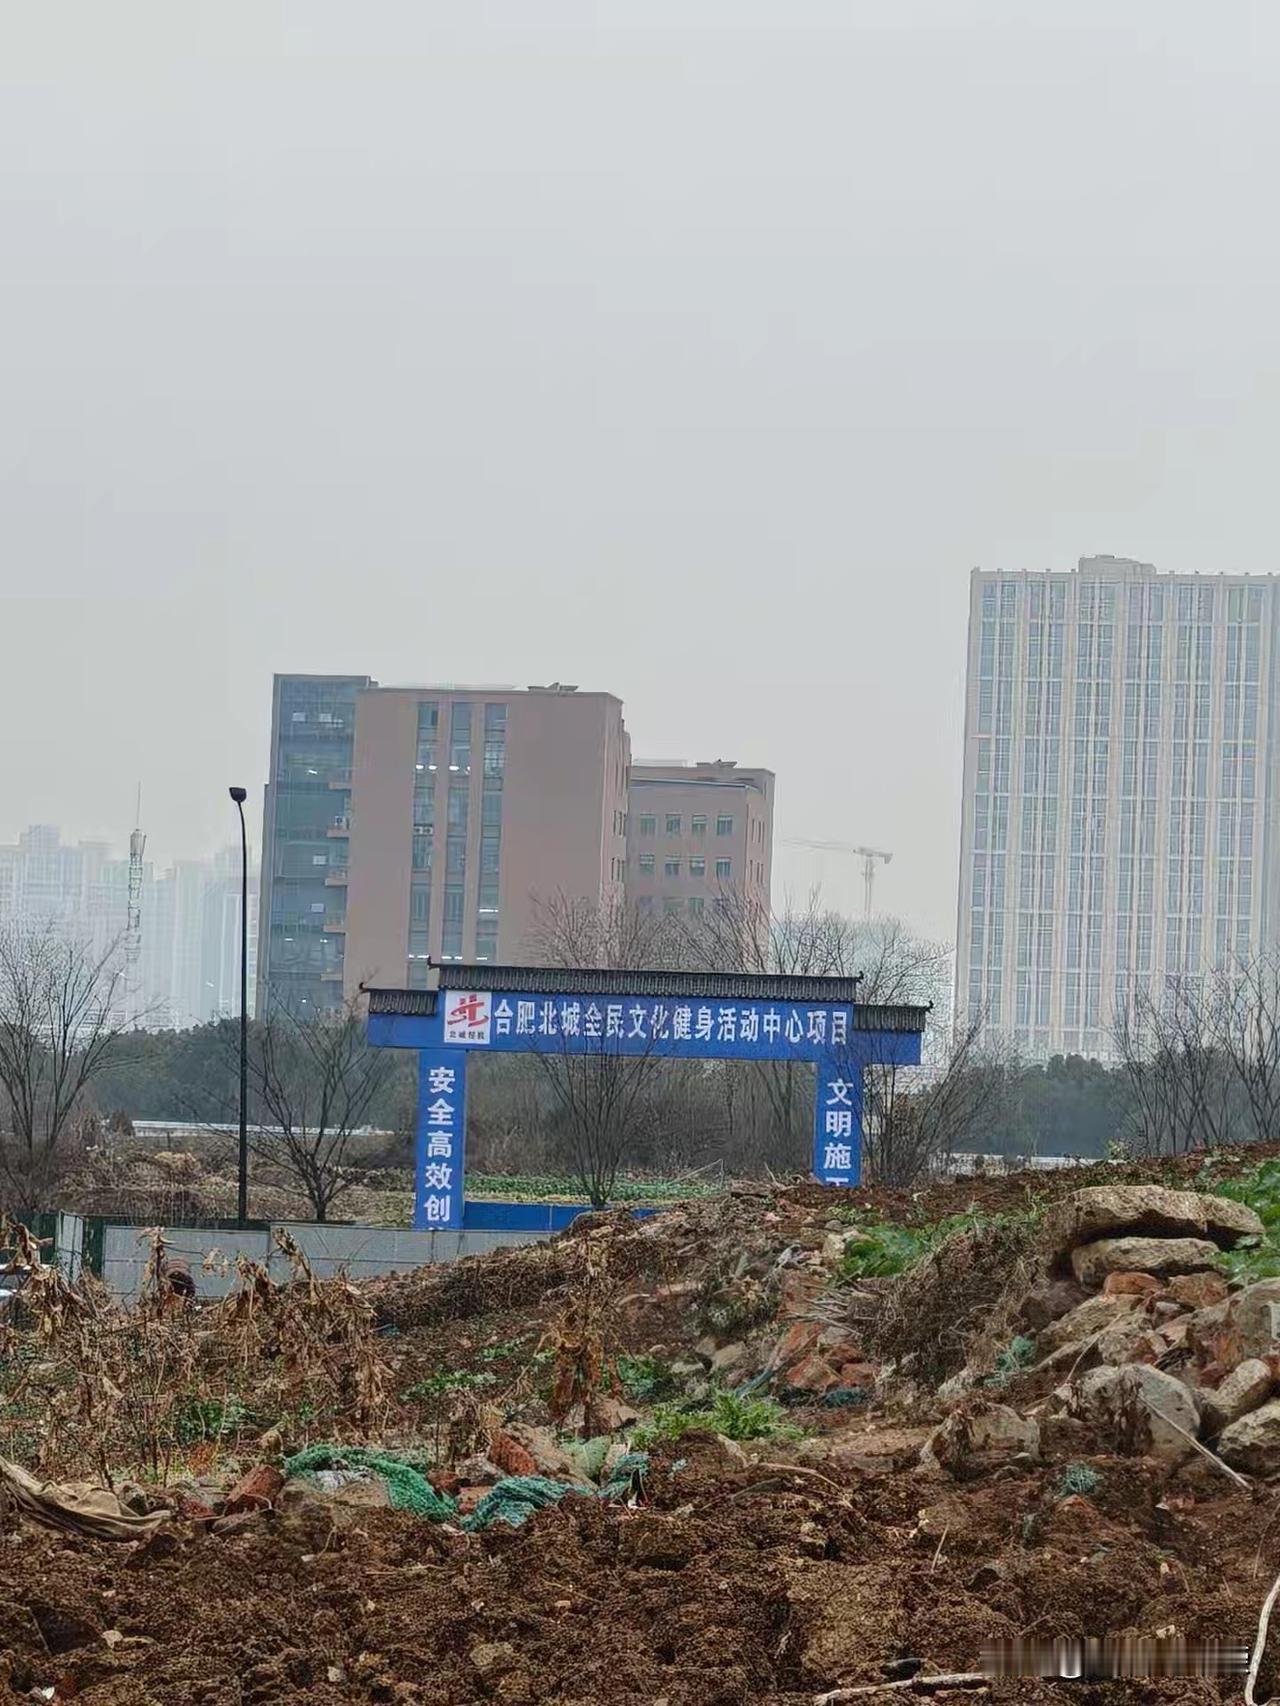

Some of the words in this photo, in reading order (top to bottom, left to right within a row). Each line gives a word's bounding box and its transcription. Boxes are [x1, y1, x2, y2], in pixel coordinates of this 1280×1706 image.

[494, 998, 848, 1046] 合肥北城全民文化健身活动中心项目
[424, 1066, 456, 1229] 安全高效创
